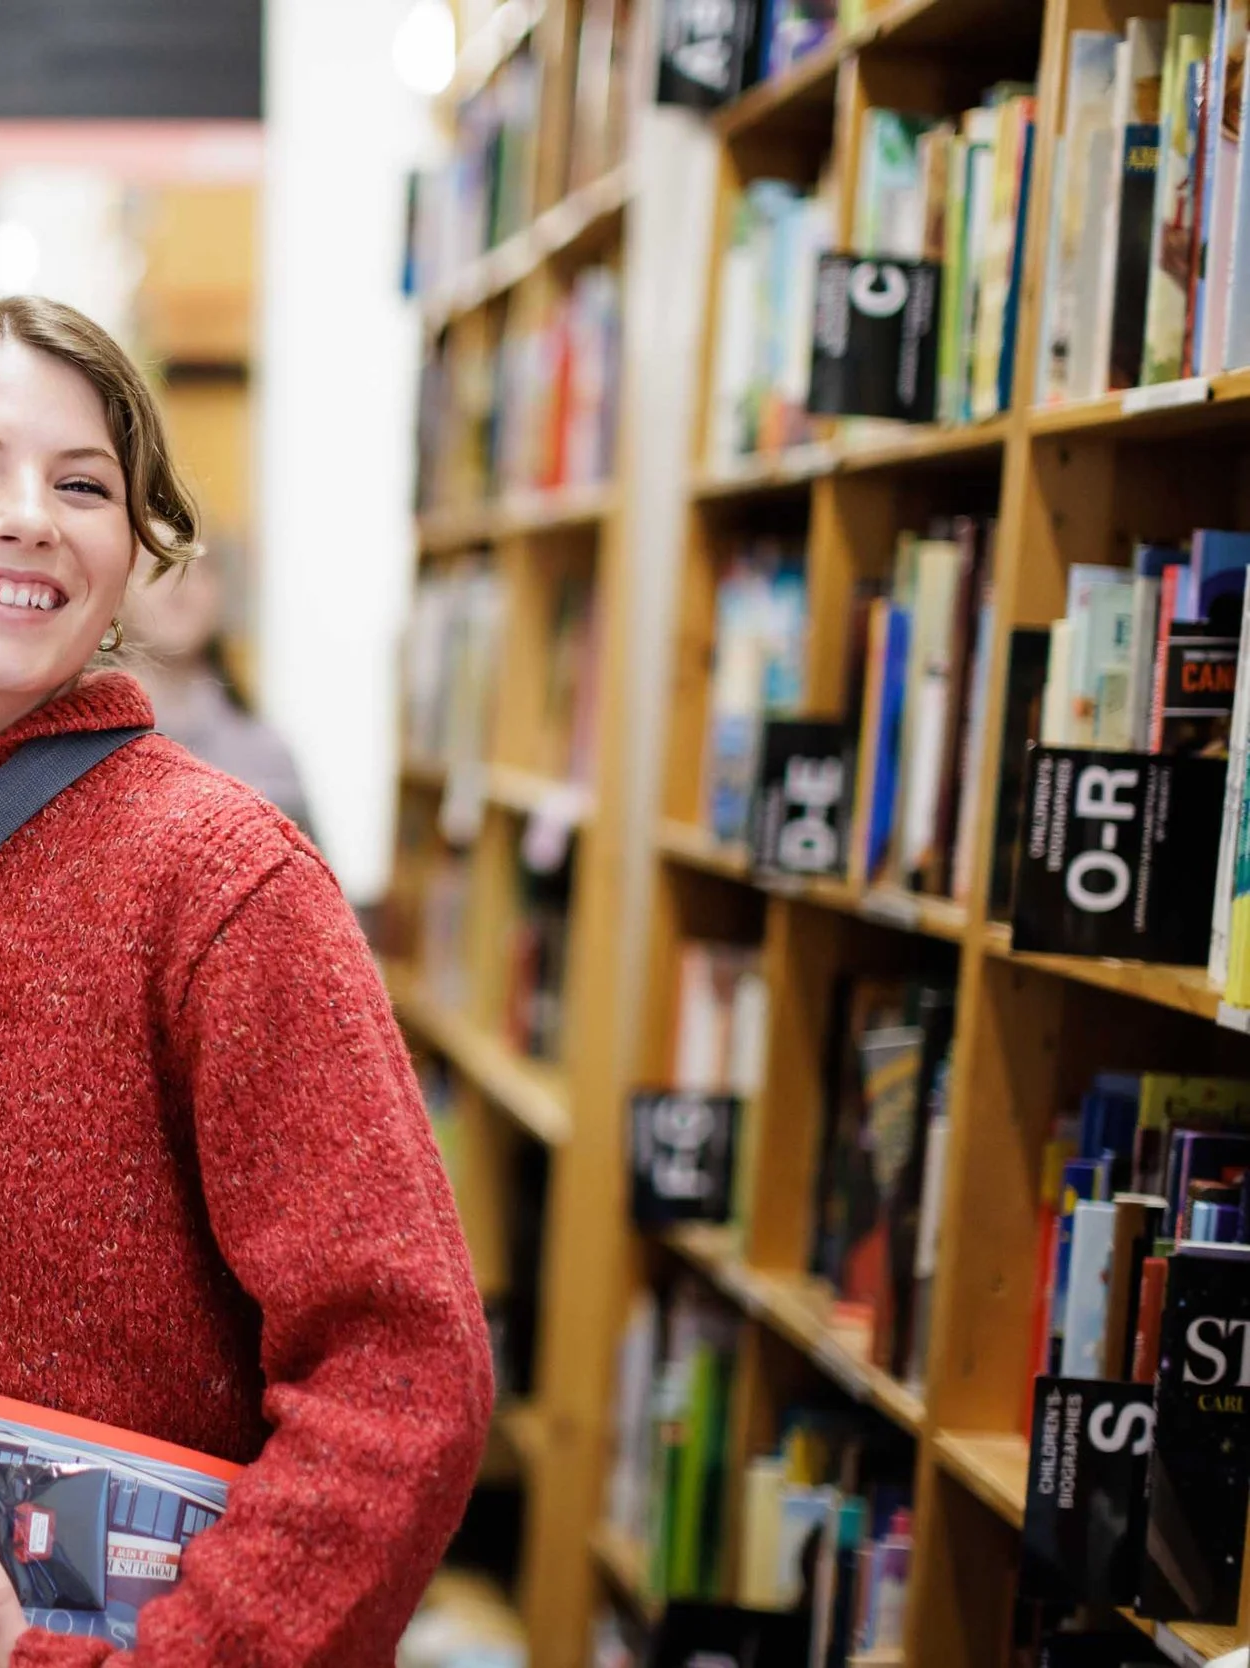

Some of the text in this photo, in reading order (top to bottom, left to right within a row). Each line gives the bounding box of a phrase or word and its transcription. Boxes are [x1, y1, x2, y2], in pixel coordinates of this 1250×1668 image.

[849, 260, 909, 318] C
[1065, 764, 1140, 914] O-R
[1037, 1394, 1063, 1494] CHILDREN'S
[1056, 1392, 1084, 1510] BIOGRAPHIES
[1087, 1400, 1158, 1457] S
